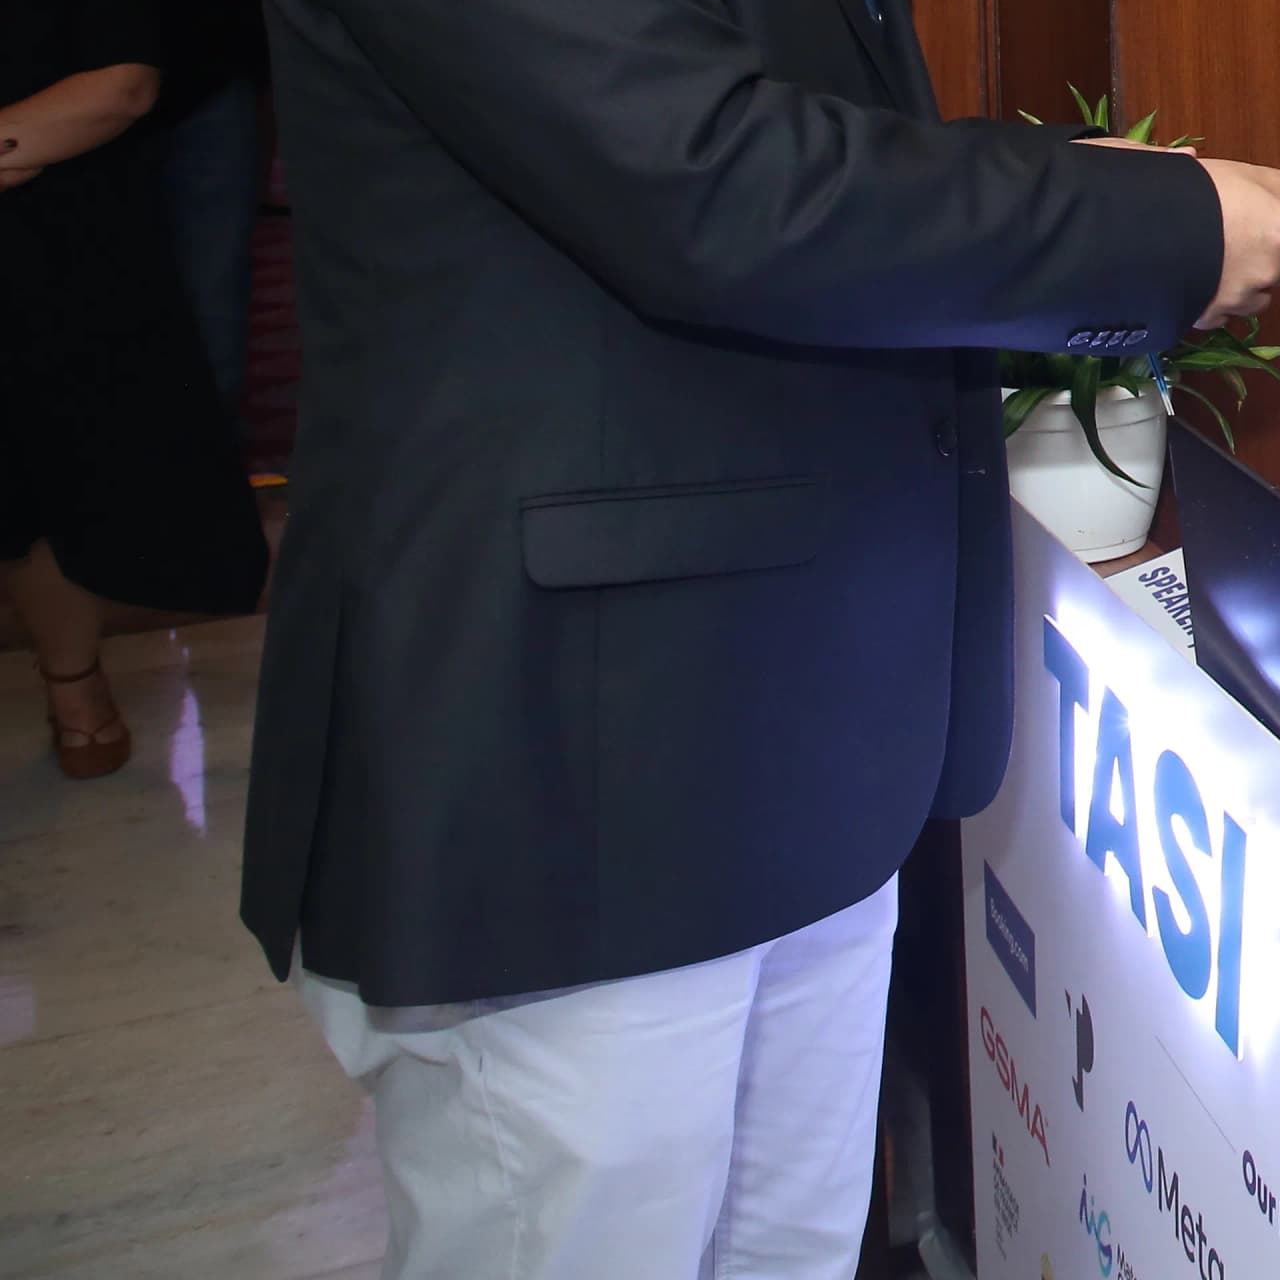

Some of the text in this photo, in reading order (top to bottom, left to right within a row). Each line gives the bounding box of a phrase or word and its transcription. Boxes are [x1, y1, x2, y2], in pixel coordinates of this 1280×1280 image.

[1043, 615, 1248, 1060] TASI
[980, 1005, 1049, 1168] GSMA
[1242, 1149, 1277, 1225] Our
